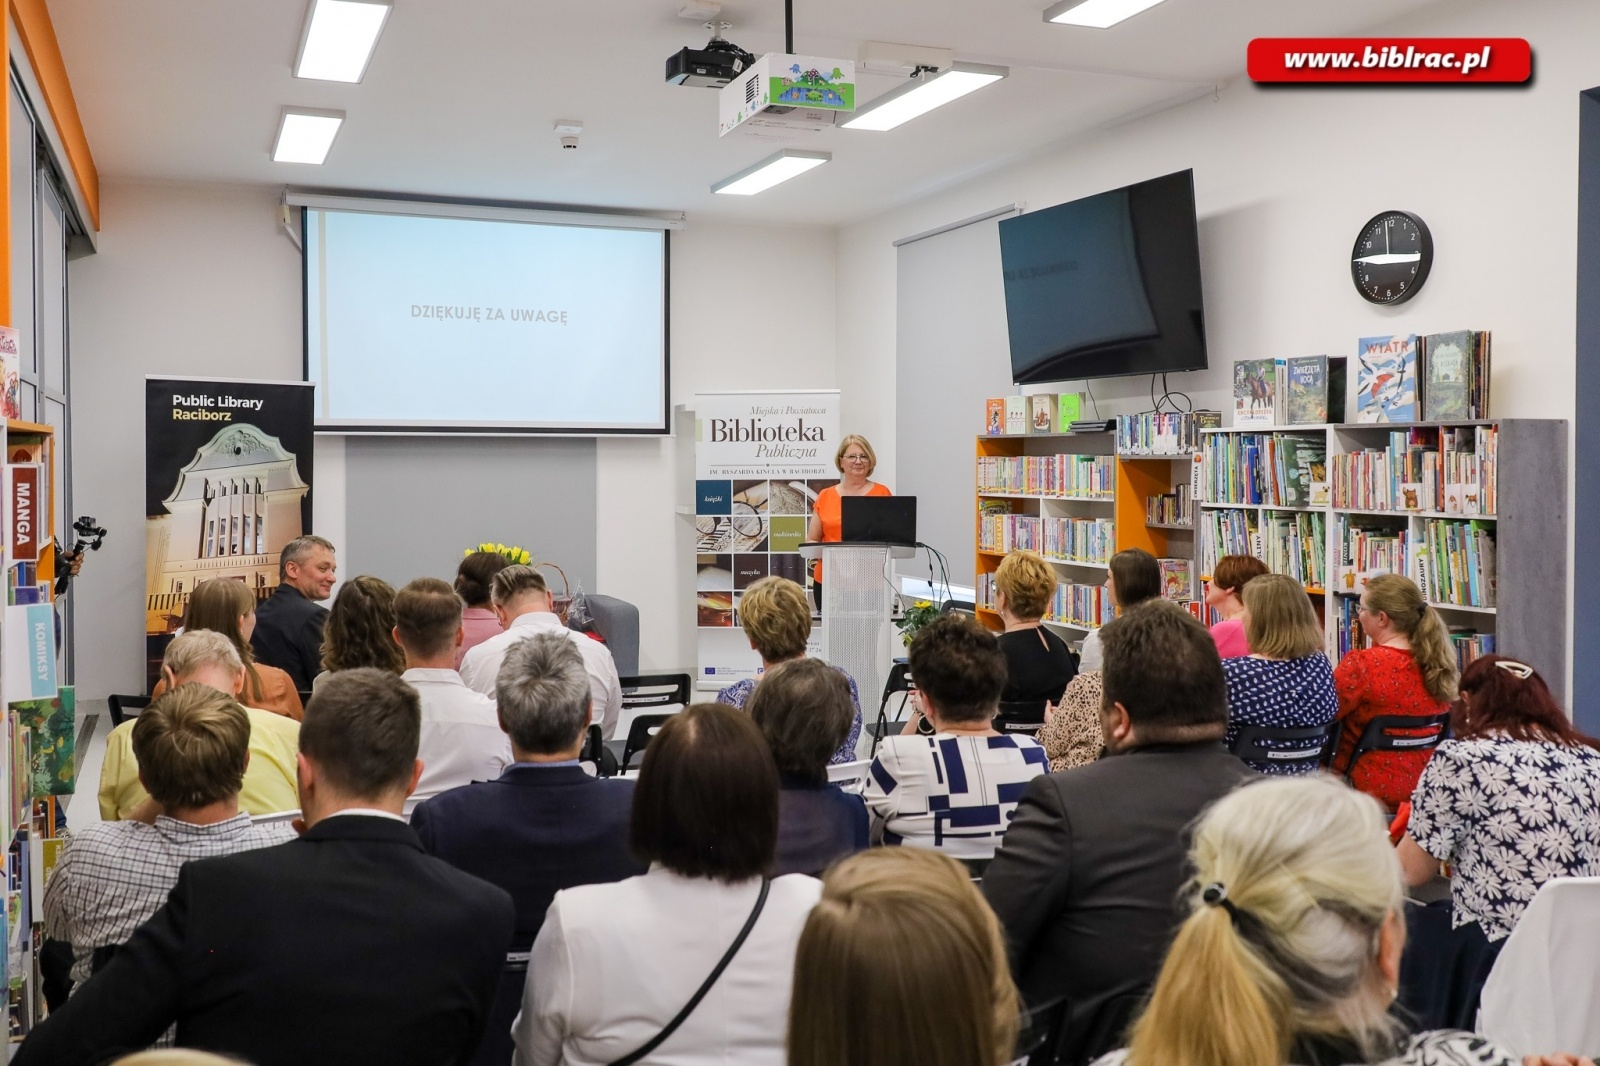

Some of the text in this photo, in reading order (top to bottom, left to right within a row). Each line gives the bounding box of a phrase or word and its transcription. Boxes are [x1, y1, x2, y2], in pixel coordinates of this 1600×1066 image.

[1366, 241, 1372, 249] 10
[1410, 233, 1416, 241] 2
[1386, 289, 1391, 297] 6
[411, 304, 568, 326] DZIĘKUJĘ ZA UWAGĘ
[1366, 341, 1409, 355] WIATR
[172, 394, 264, 410] Public Library
[172, 408, 232, 421] Raciborz
[749, 406, 780, 418] Miejska
[785, 405, 827, 415] Powiatowa
[709, 418, 826, 443] Biblioteka
[755, 443, 817, 460] Publiczna
[16, 482, 31, 546] MANGA
[1418, 558, 1428, 601] DINOZAURY
[35, 622, 48, 682] KOMIKSY
